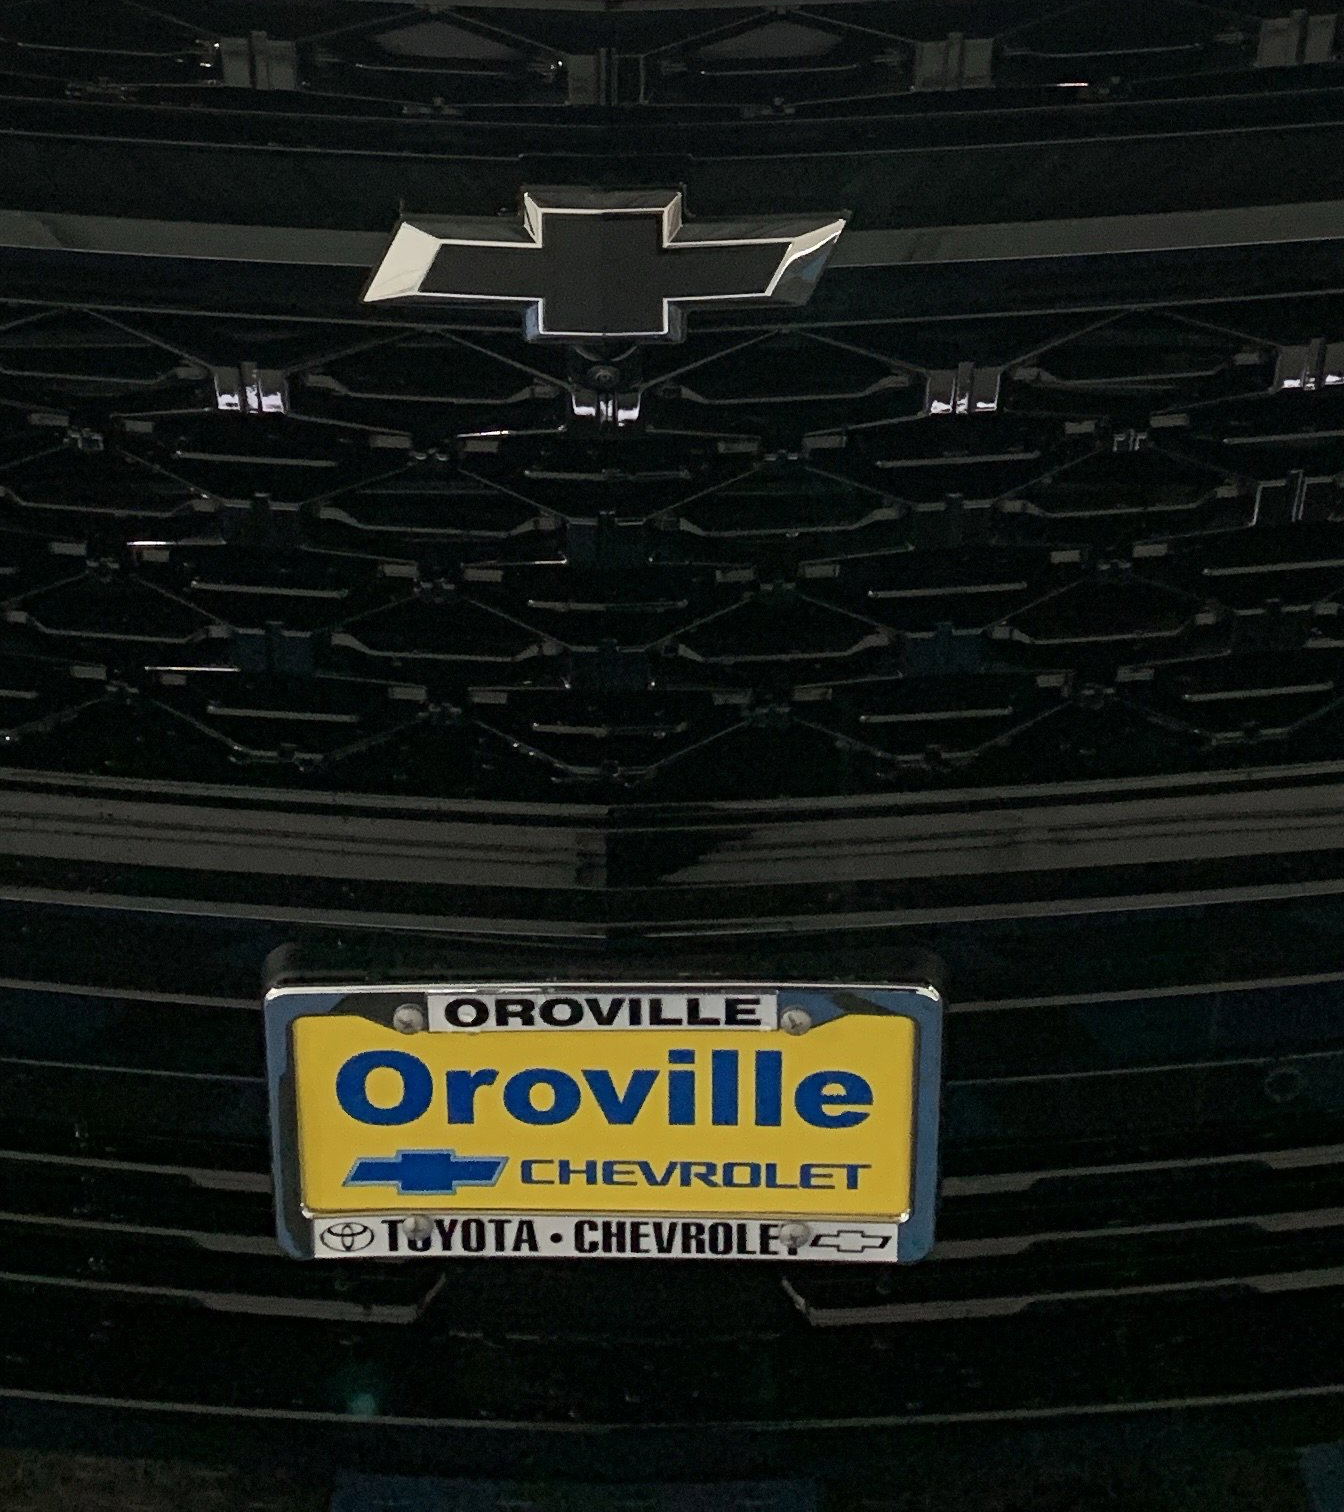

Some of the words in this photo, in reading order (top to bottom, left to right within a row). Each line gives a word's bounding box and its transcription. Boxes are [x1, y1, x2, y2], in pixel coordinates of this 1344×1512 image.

[444, 997, 762, 1028] OROVILLE
[335, 1048, 874, 1129] Oroville
[520, 1159, 872, 1190] CHEVROLET
[573, 1220, 804, 1256] CHEVROLE
